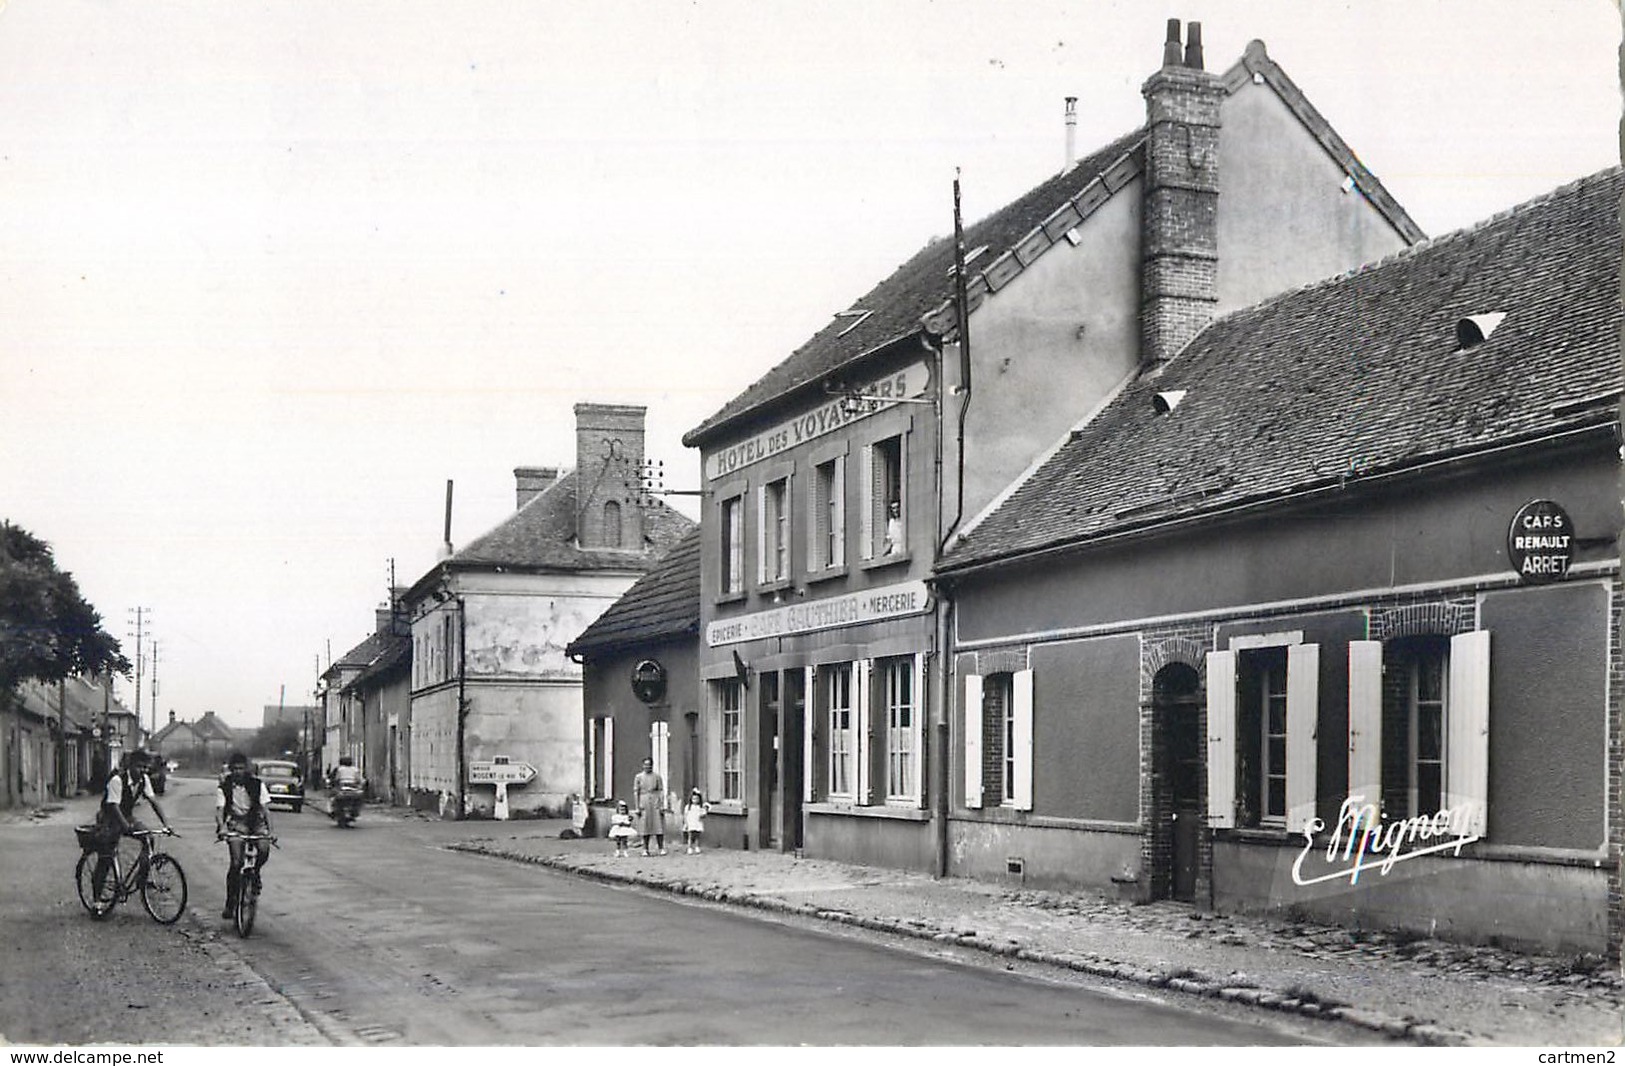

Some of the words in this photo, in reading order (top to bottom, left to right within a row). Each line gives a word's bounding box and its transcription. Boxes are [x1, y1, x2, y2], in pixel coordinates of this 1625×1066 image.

[717, 439, 765, 475] HOTEL
[768, 430, 788, 453] DES
[1523, 515, 1563, 528] CARS
[1515, 535, 1570, 549] RENAULT
[1521, 555, 1568, 574] ARRET
[712, 623, 742, 643] EPICERIE
[869, 591, 917, 613] MERCERIE
